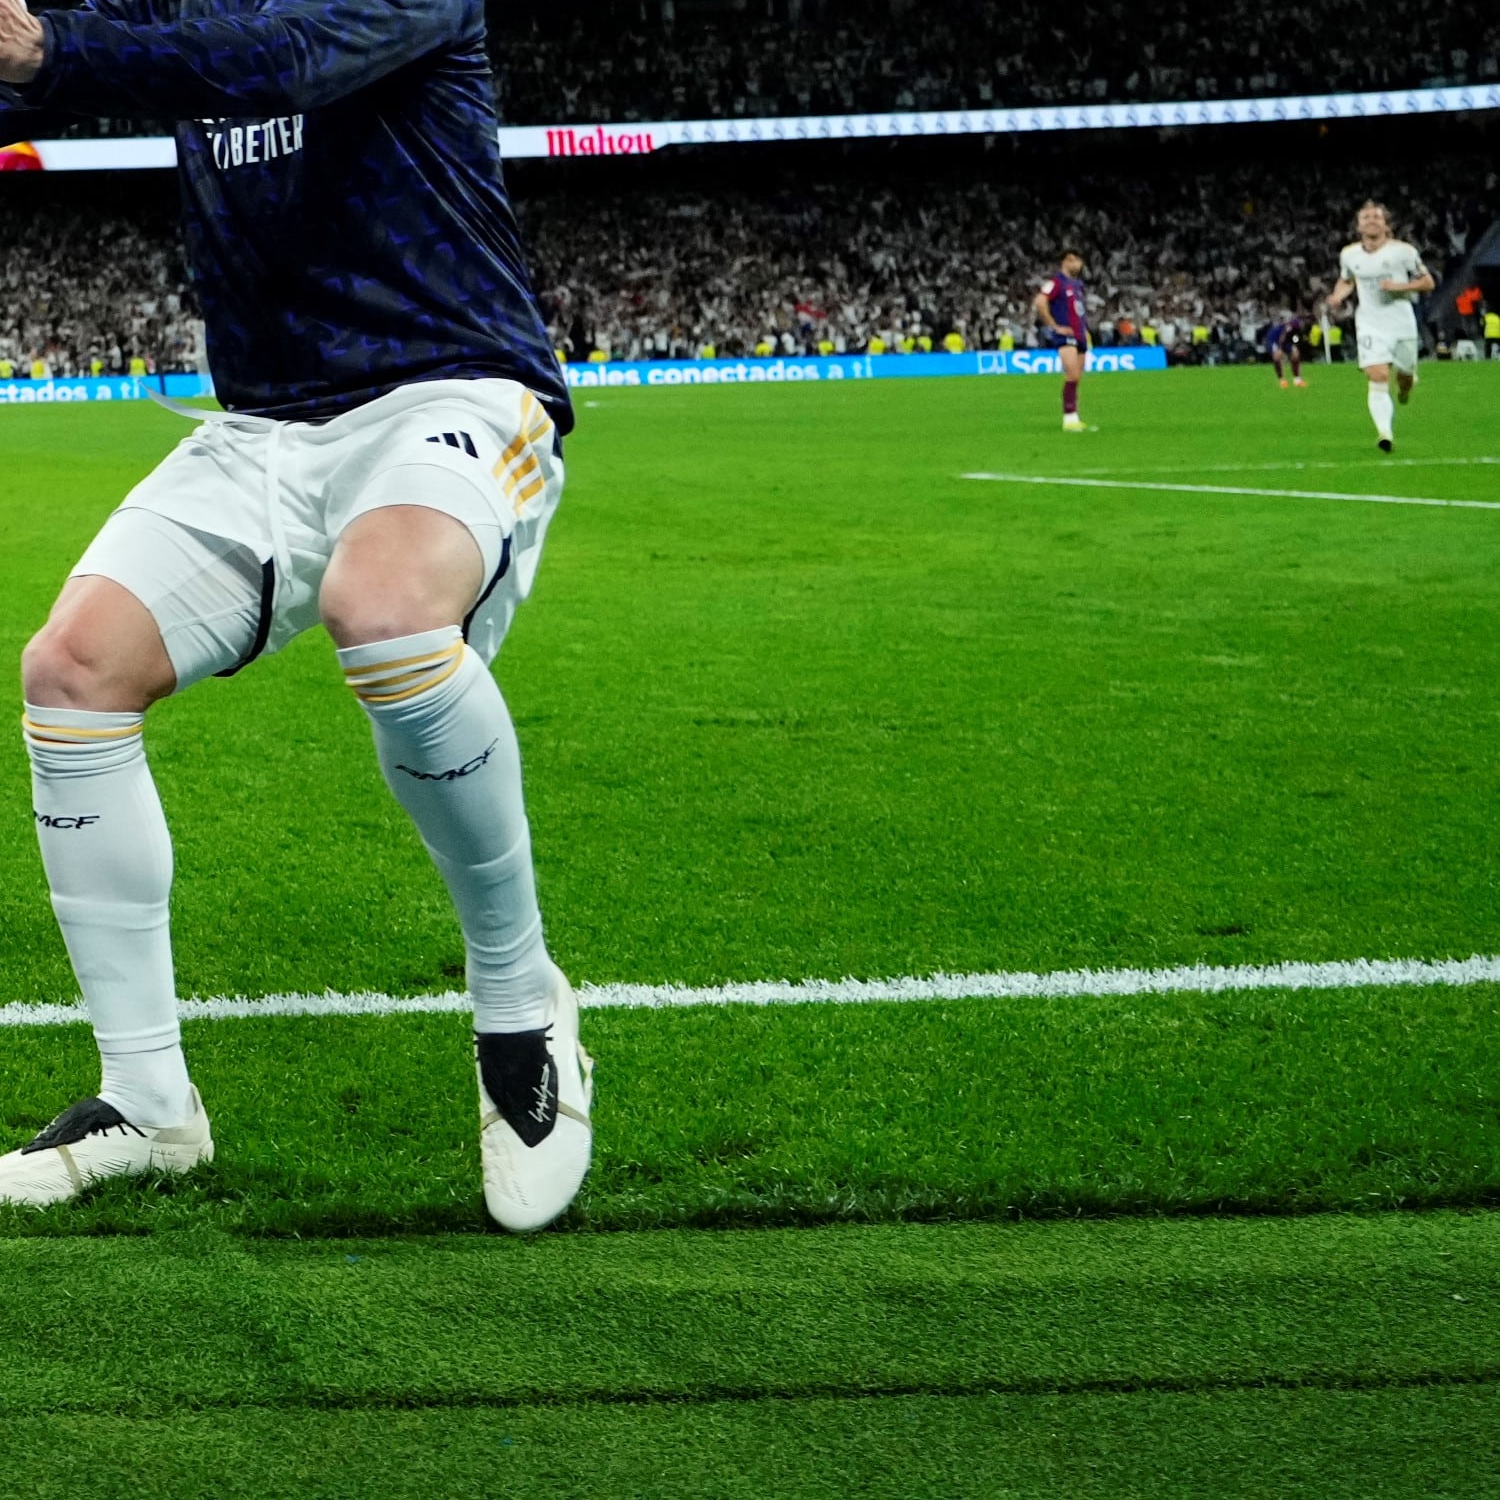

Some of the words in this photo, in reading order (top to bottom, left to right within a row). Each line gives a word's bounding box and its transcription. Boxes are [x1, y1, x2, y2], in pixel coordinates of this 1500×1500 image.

[546, 125, 656, 157] Mahou
[649, 359, 818, 384] conectados
[33, 810, 100, 829] MCF
